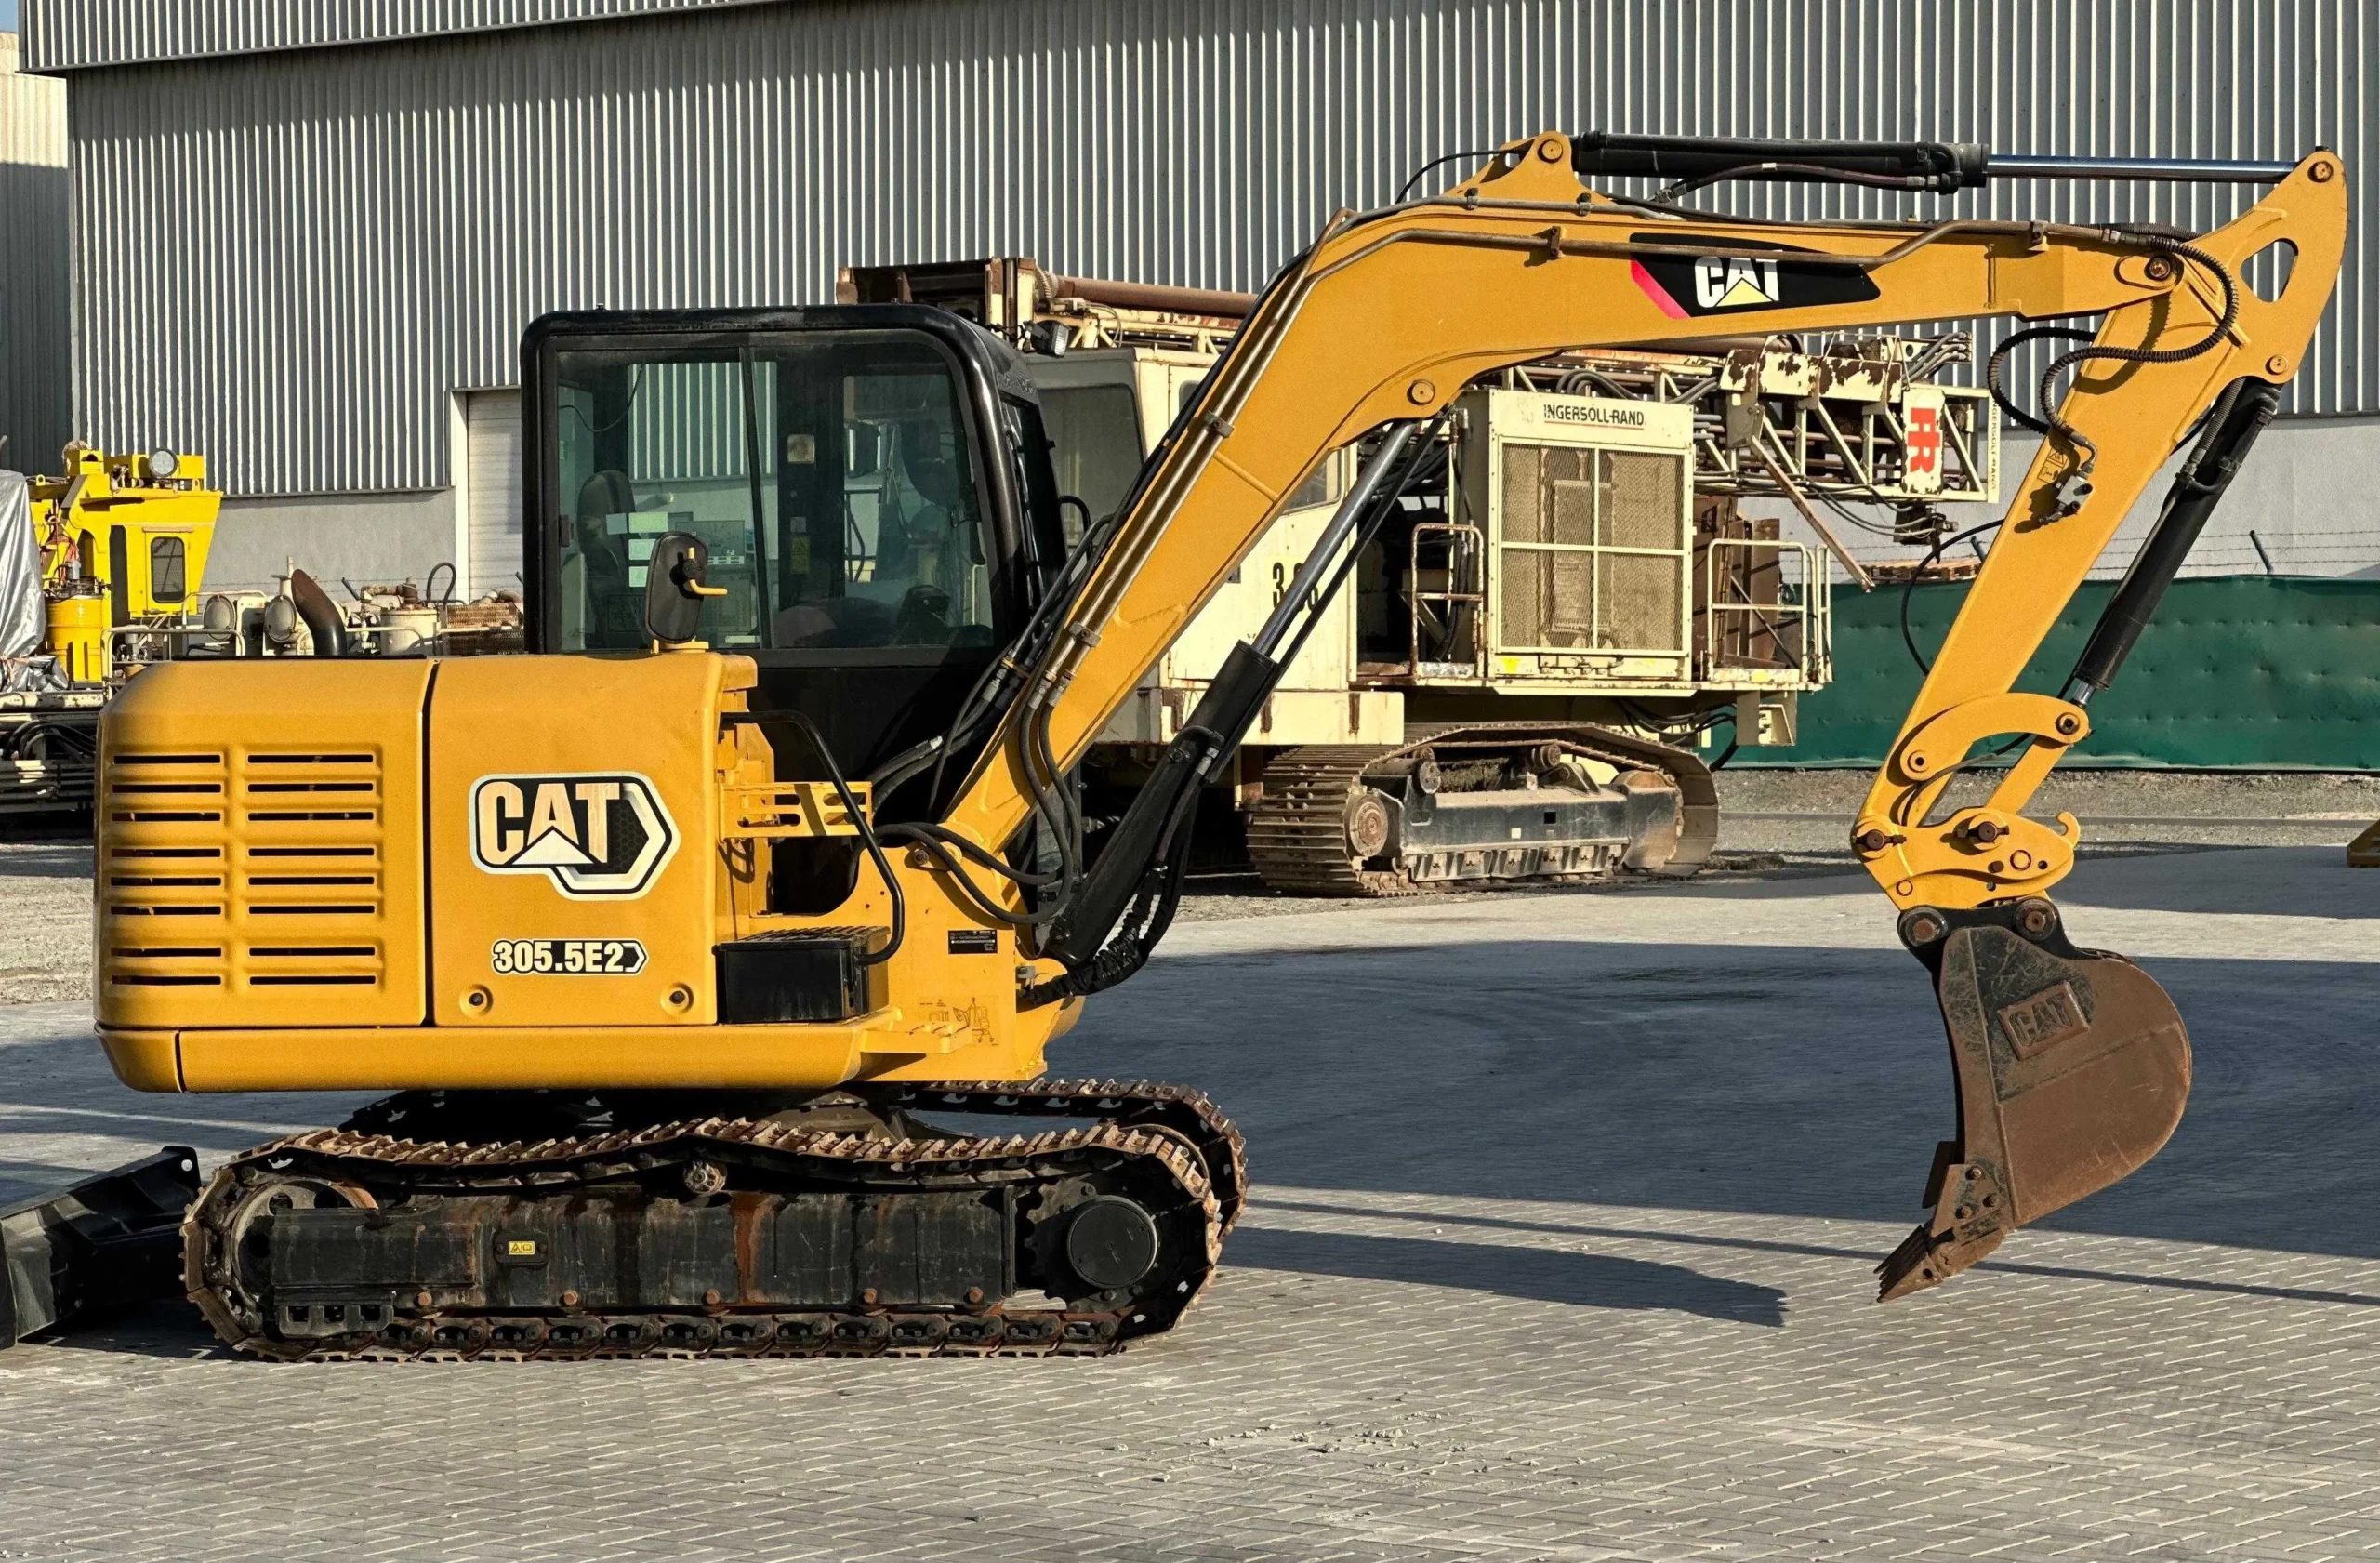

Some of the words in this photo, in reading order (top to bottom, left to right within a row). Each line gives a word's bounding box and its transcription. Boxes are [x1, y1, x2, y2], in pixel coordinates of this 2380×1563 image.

[1694, 248, 1783, 309] CAT
[1543, 404, 1646, 426] INGERSOLL-RAND
[478, 781, 620, 865] CAT
[493, 940, 625, 973] 305.5E2
[2008, 991, 2074, 1048] CAT
